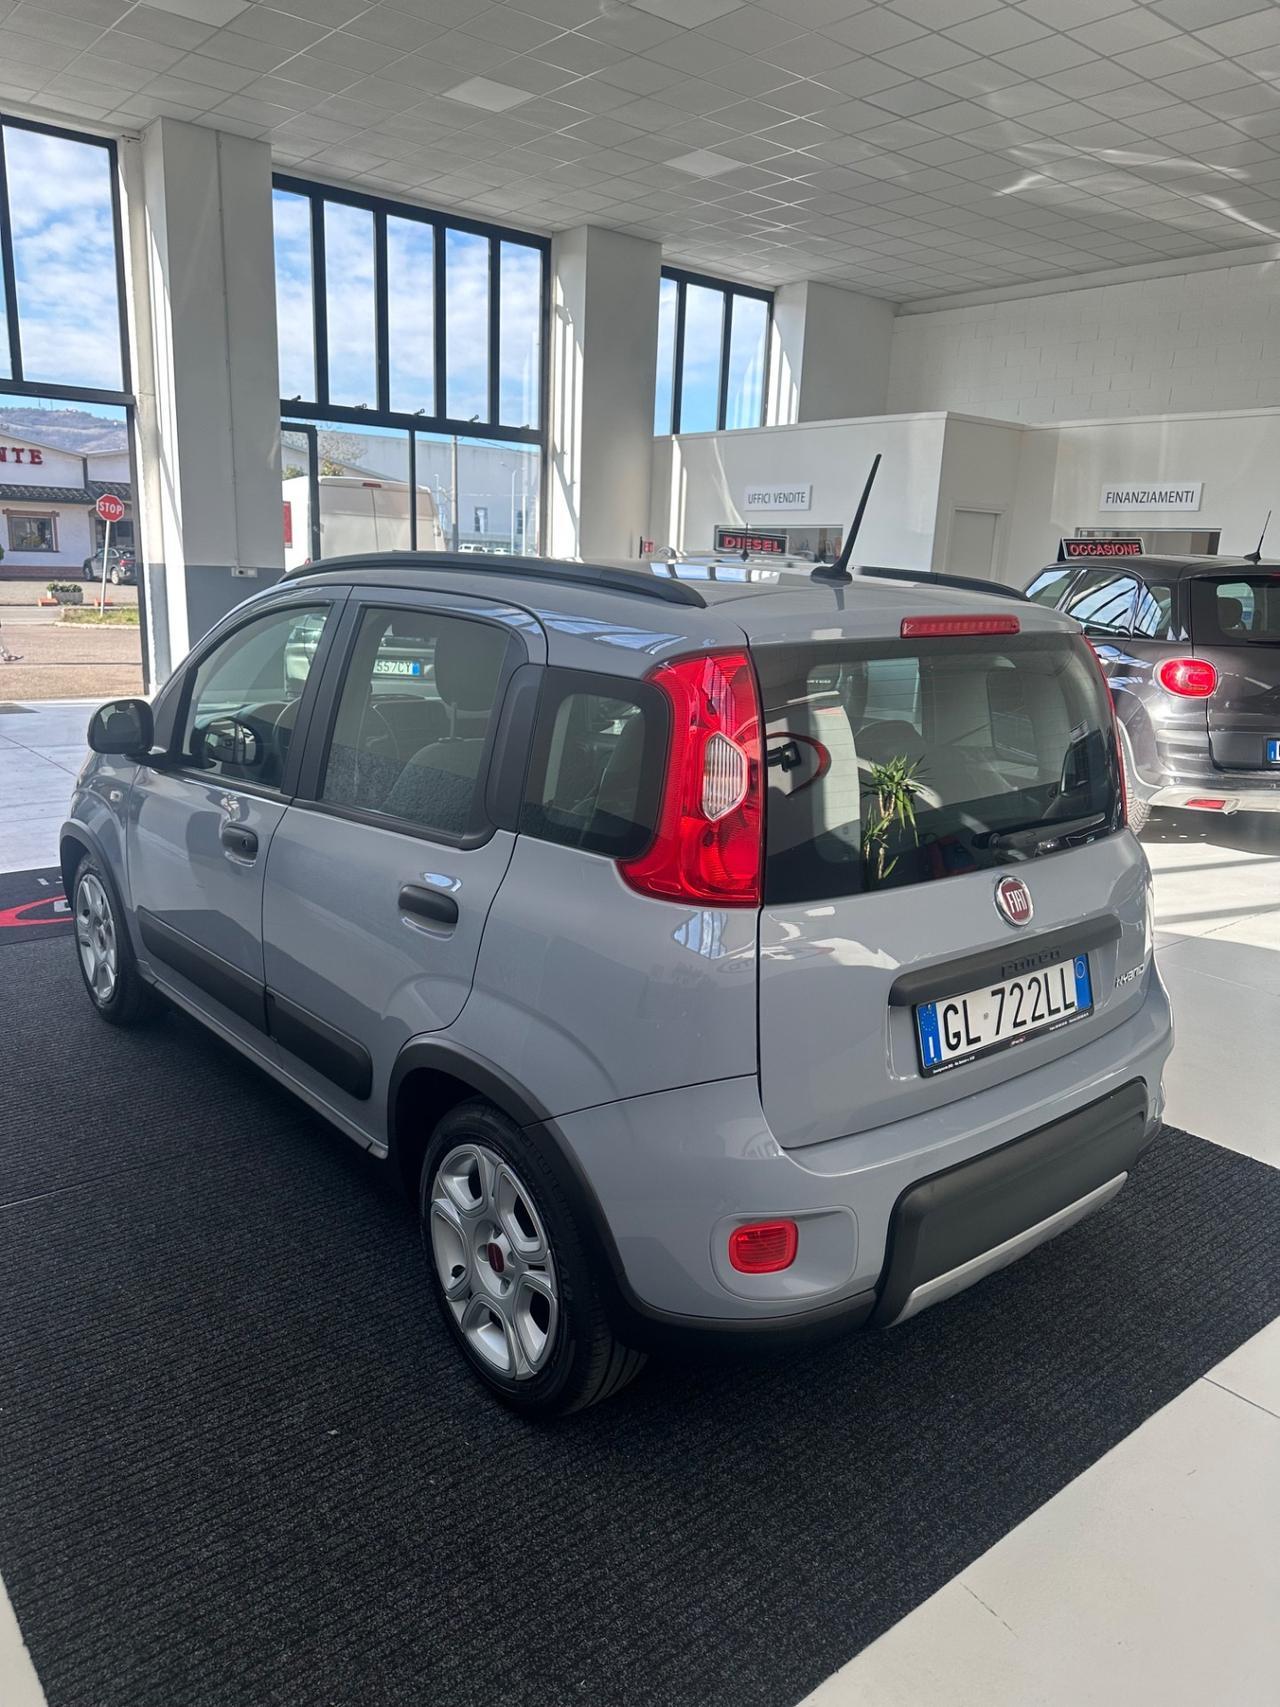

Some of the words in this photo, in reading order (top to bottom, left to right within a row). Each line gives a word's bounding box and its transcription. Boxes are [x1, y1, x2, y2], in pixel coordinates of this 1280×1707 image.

[748, 493, 771, 505] UFFICI
[774, 491, 806, 504] VENDITE
[1105, 490, 1195, 504] FINANZIAMENTI
[99, 502, 123, 516] STOP
[723, 535, 782, 553] DIESEL
[1069, 543, 1140, 556] OCCASIONE
[1005, 888, 1028, 913] FIAT
[942, 999, 982, 1051] GL
[990, 967, 1076, 1036] 722LL
